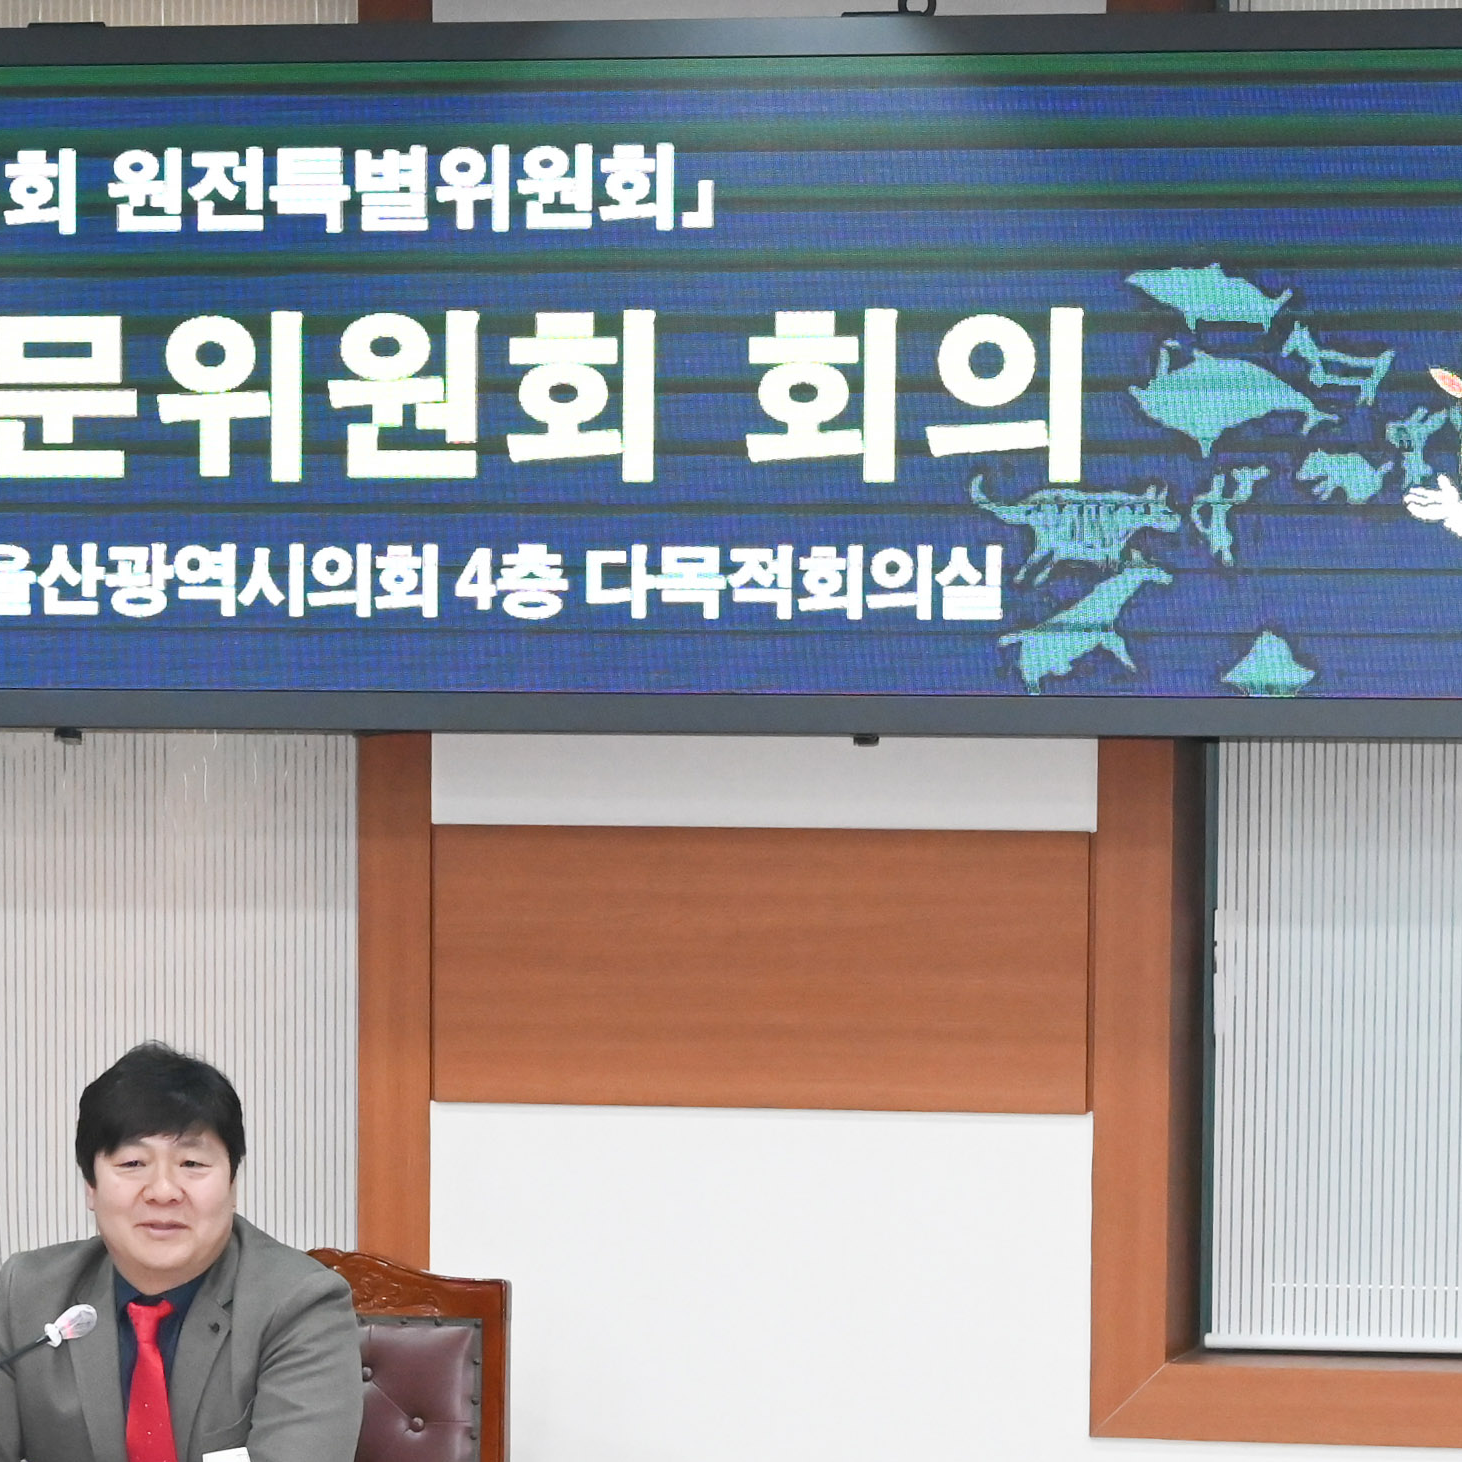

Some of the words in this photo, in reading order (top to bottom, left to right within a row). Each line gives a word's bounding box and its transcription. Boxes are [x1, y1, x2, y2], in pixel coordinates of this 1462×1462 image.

[107, 142, 715, 234] 원전특별위원회」
[745, 306, 1085, 485] 회의
[454, 543, 570, 621] 4층
[585, 543, 1004, 621] 다목적회의실
